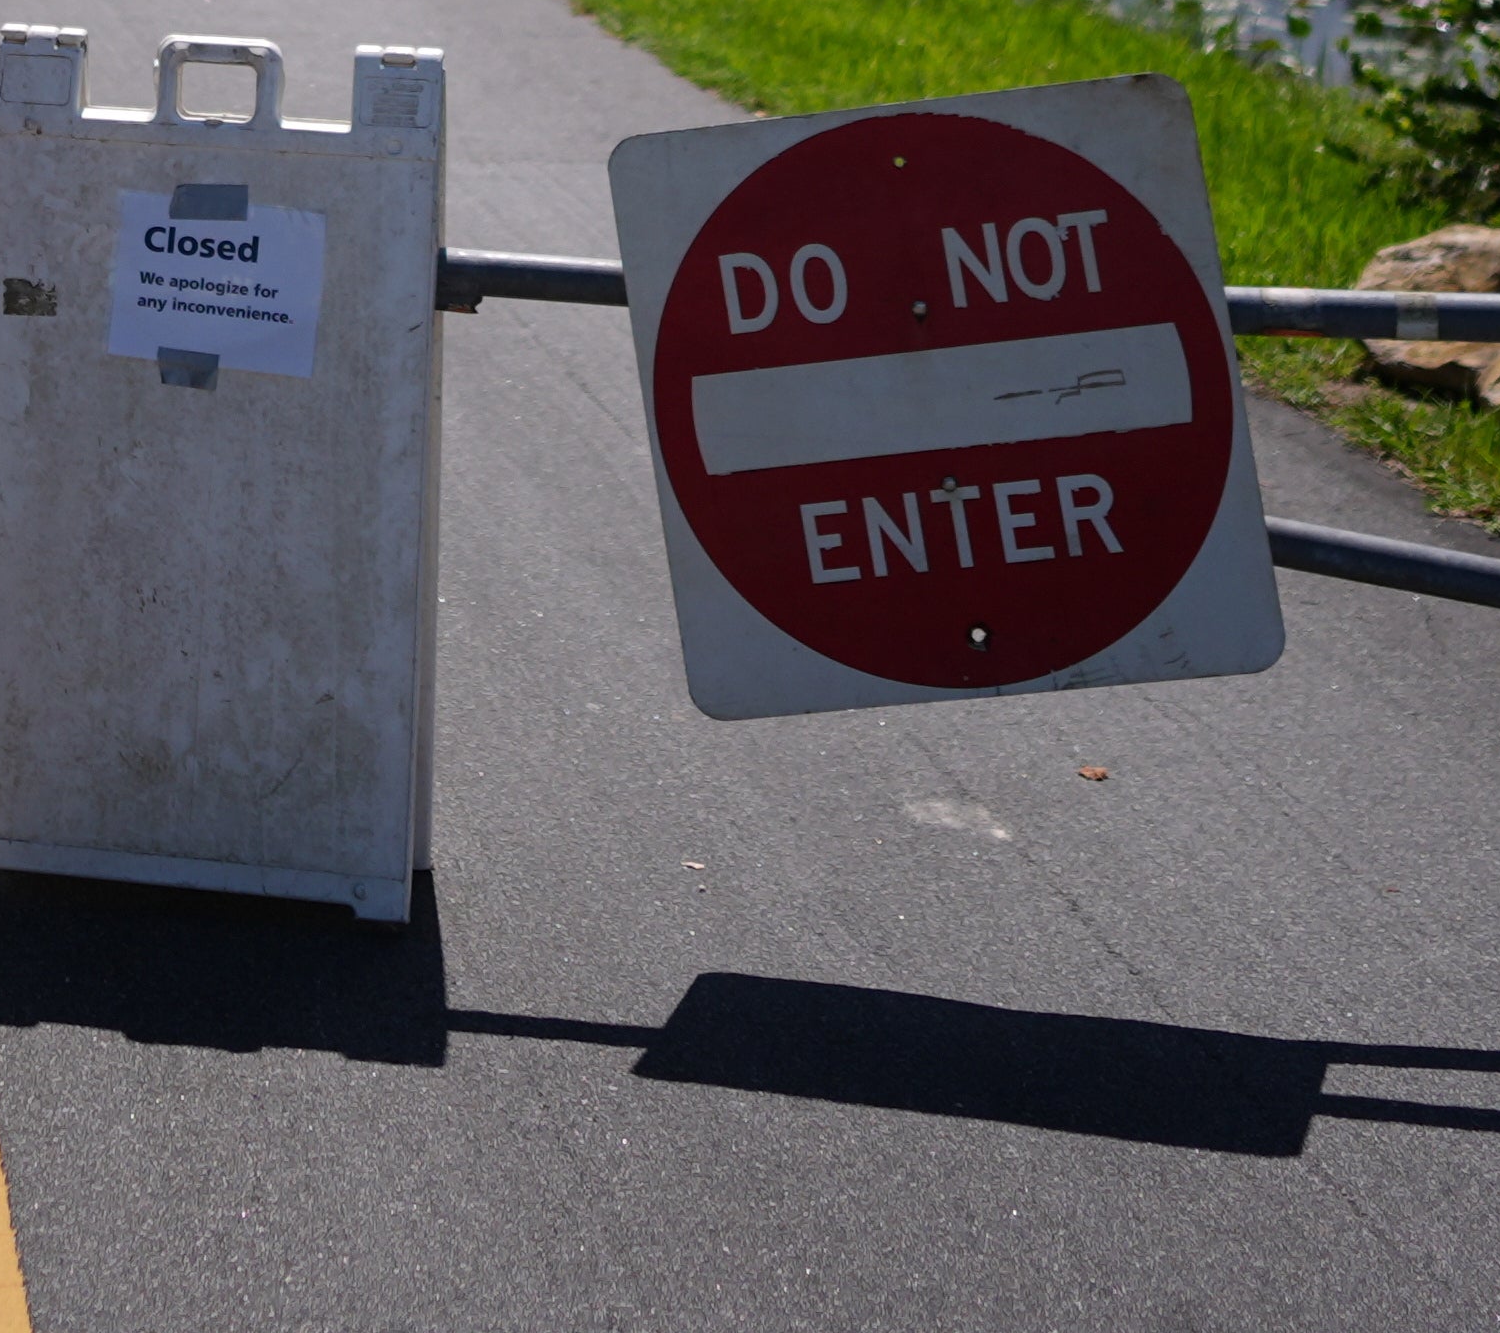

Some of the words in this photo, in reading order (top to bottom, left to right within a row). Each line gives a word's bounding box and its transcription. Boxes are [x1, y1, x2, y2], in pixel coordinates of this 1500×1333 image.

[144, 226, 260, 263] Closed
[139, 271, 165, 286] We
[169, 277, 249, 297] apologize
[253, 283, 280, 299] for
[718, 243, 848, 336] DO
[941, 209, 1109, 309] NOT
[137, 296, 167, 313] any
[172, 297, 294, 325] inconvenience.
[799, 473, 1124, 585] ENTER
